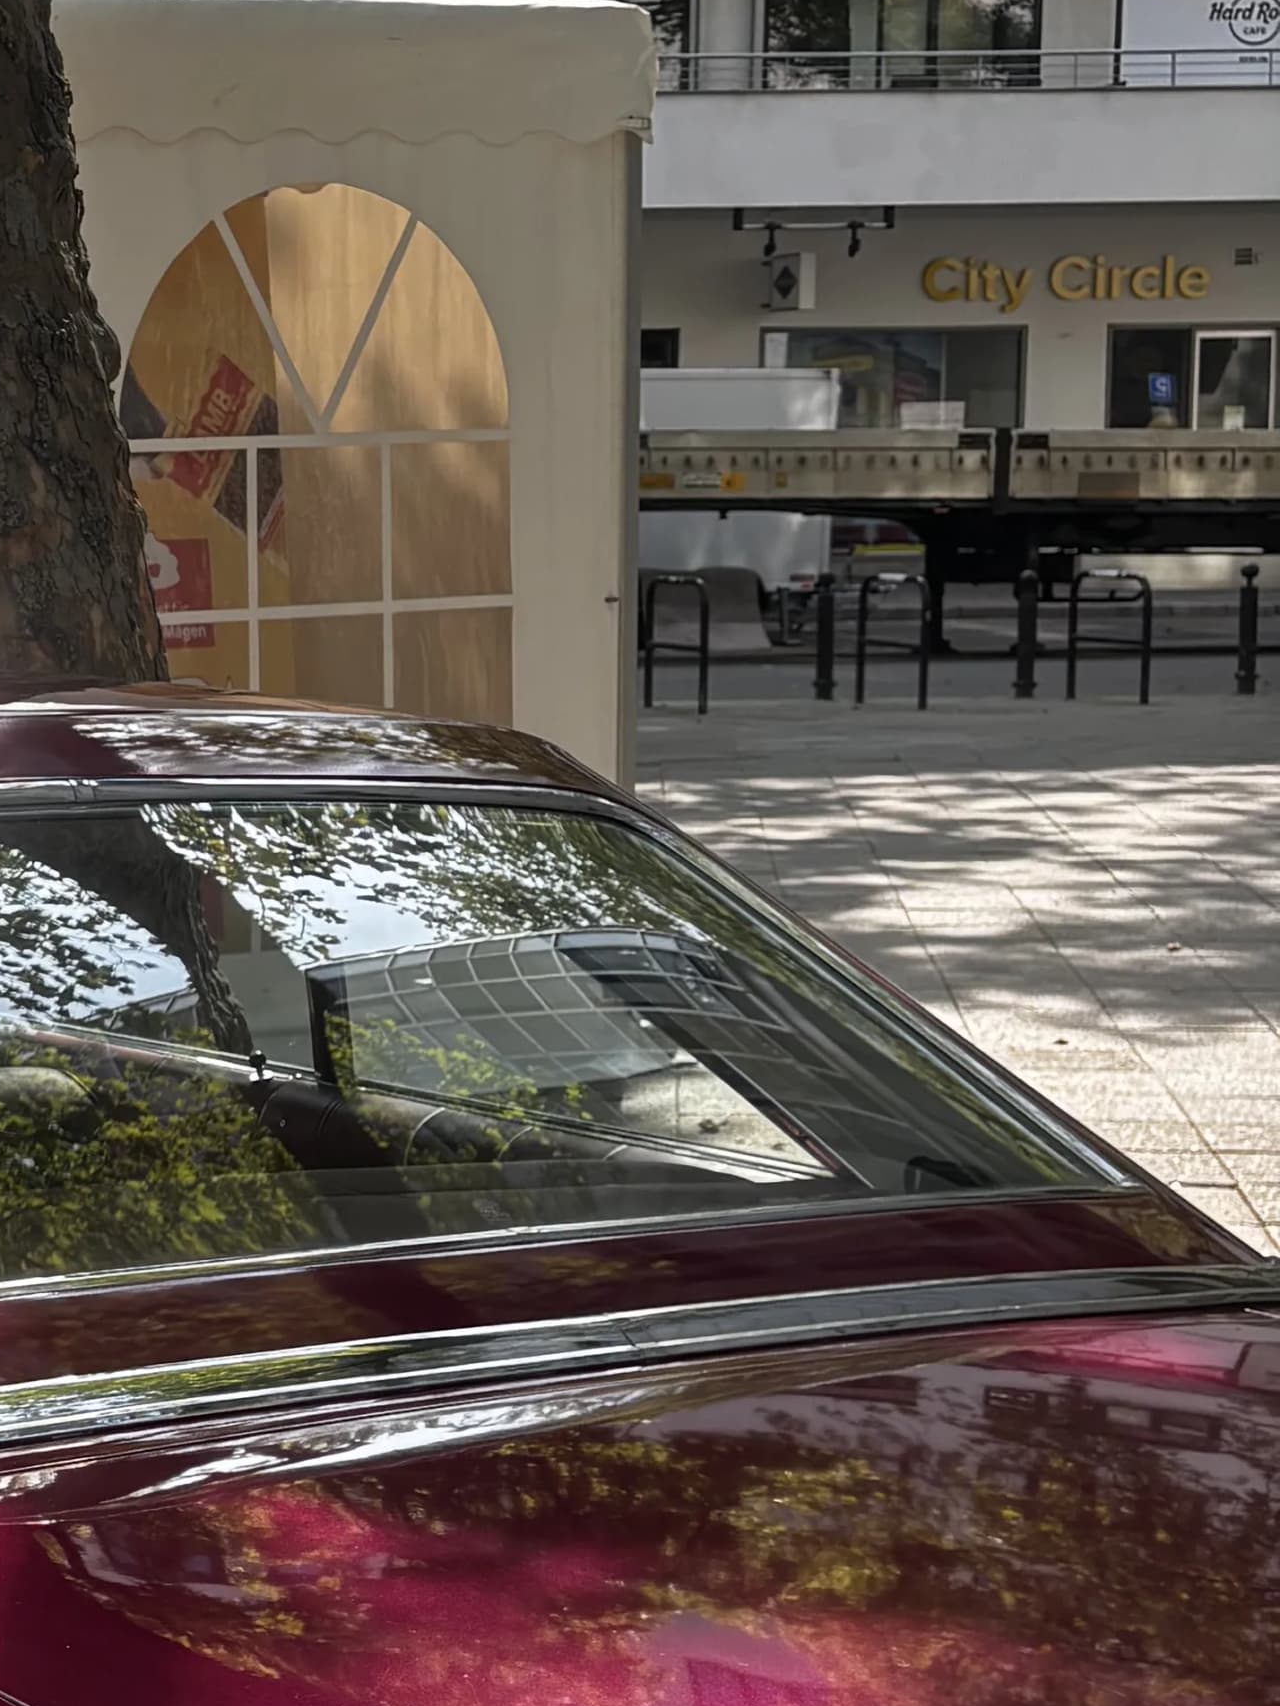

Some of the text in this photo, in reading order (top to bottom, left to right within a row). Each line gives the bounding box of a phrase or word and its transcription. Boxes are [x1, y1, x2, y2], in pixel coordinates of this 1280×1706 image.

[1208, 1, 1280, 25] Hard Ro
[921, 253, 1211, 313] City Circle
